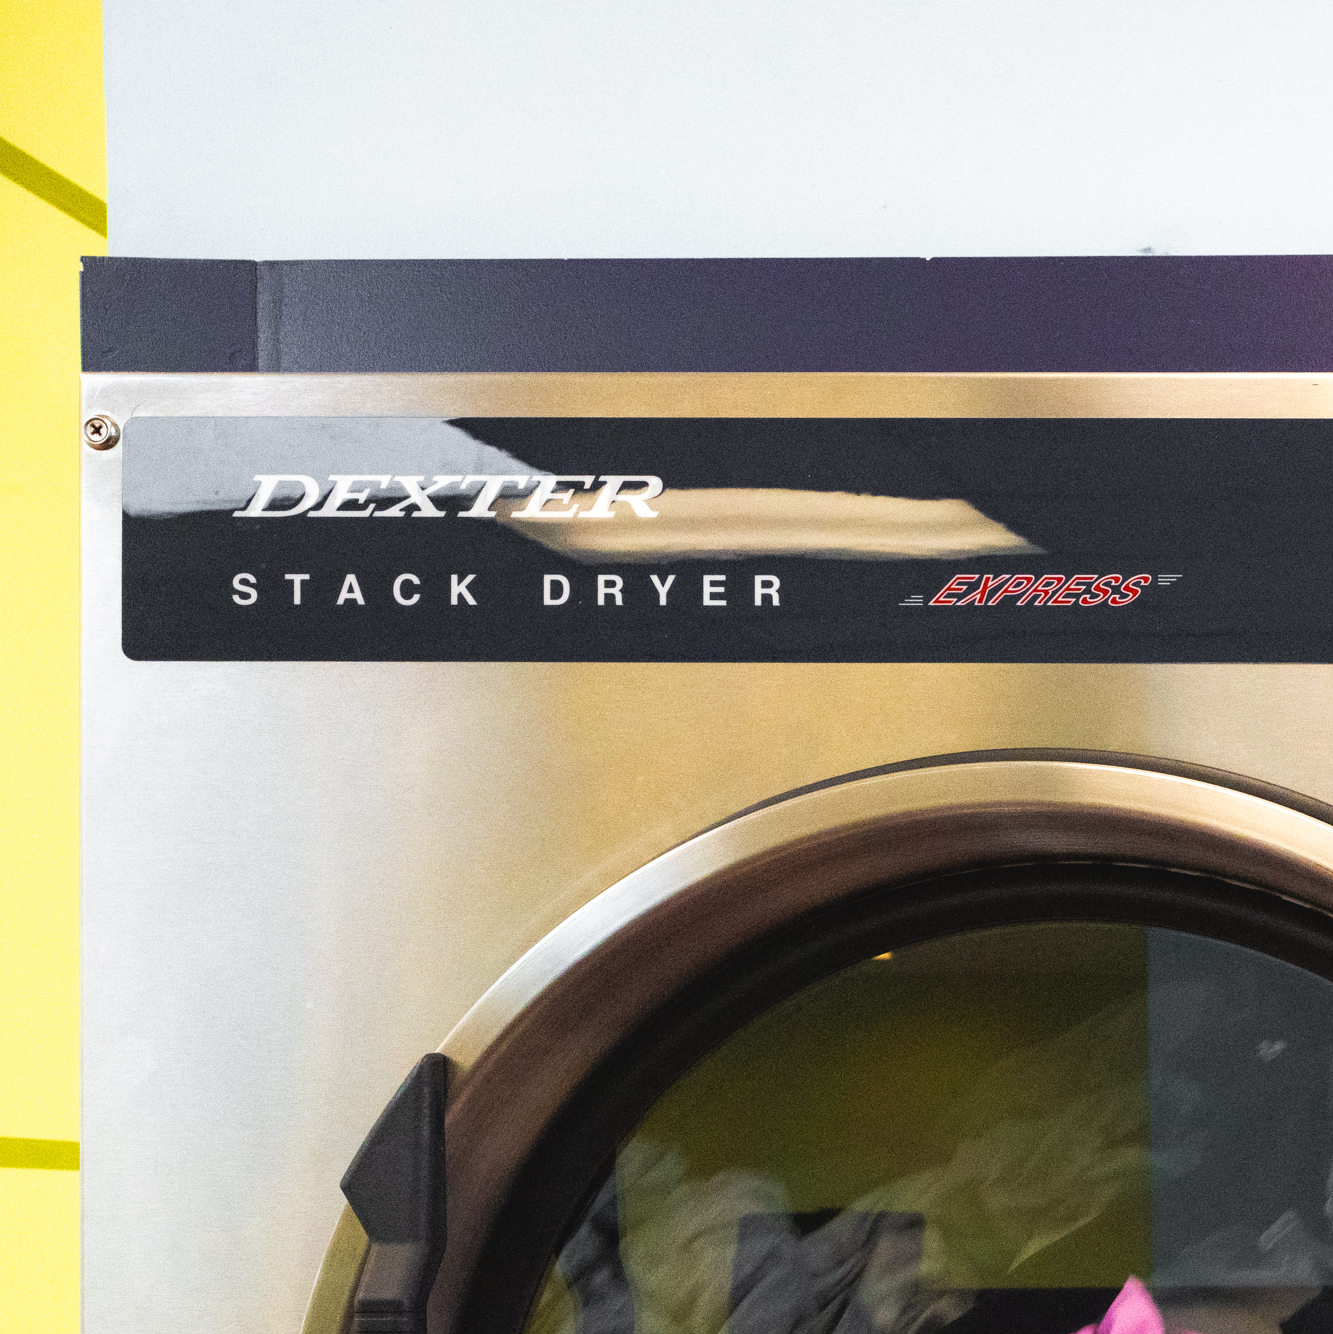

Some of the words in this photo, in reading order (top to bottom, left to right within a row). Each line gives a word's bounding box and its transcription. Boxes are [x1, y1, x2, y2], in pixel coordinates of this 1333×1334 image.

[231, 474, 665, 518] DEXTER
[231, 573, 480, 607] STACK
[543, 573, 782, 607] DRYER
[928, 574, 1152, 606] EXPRESS
